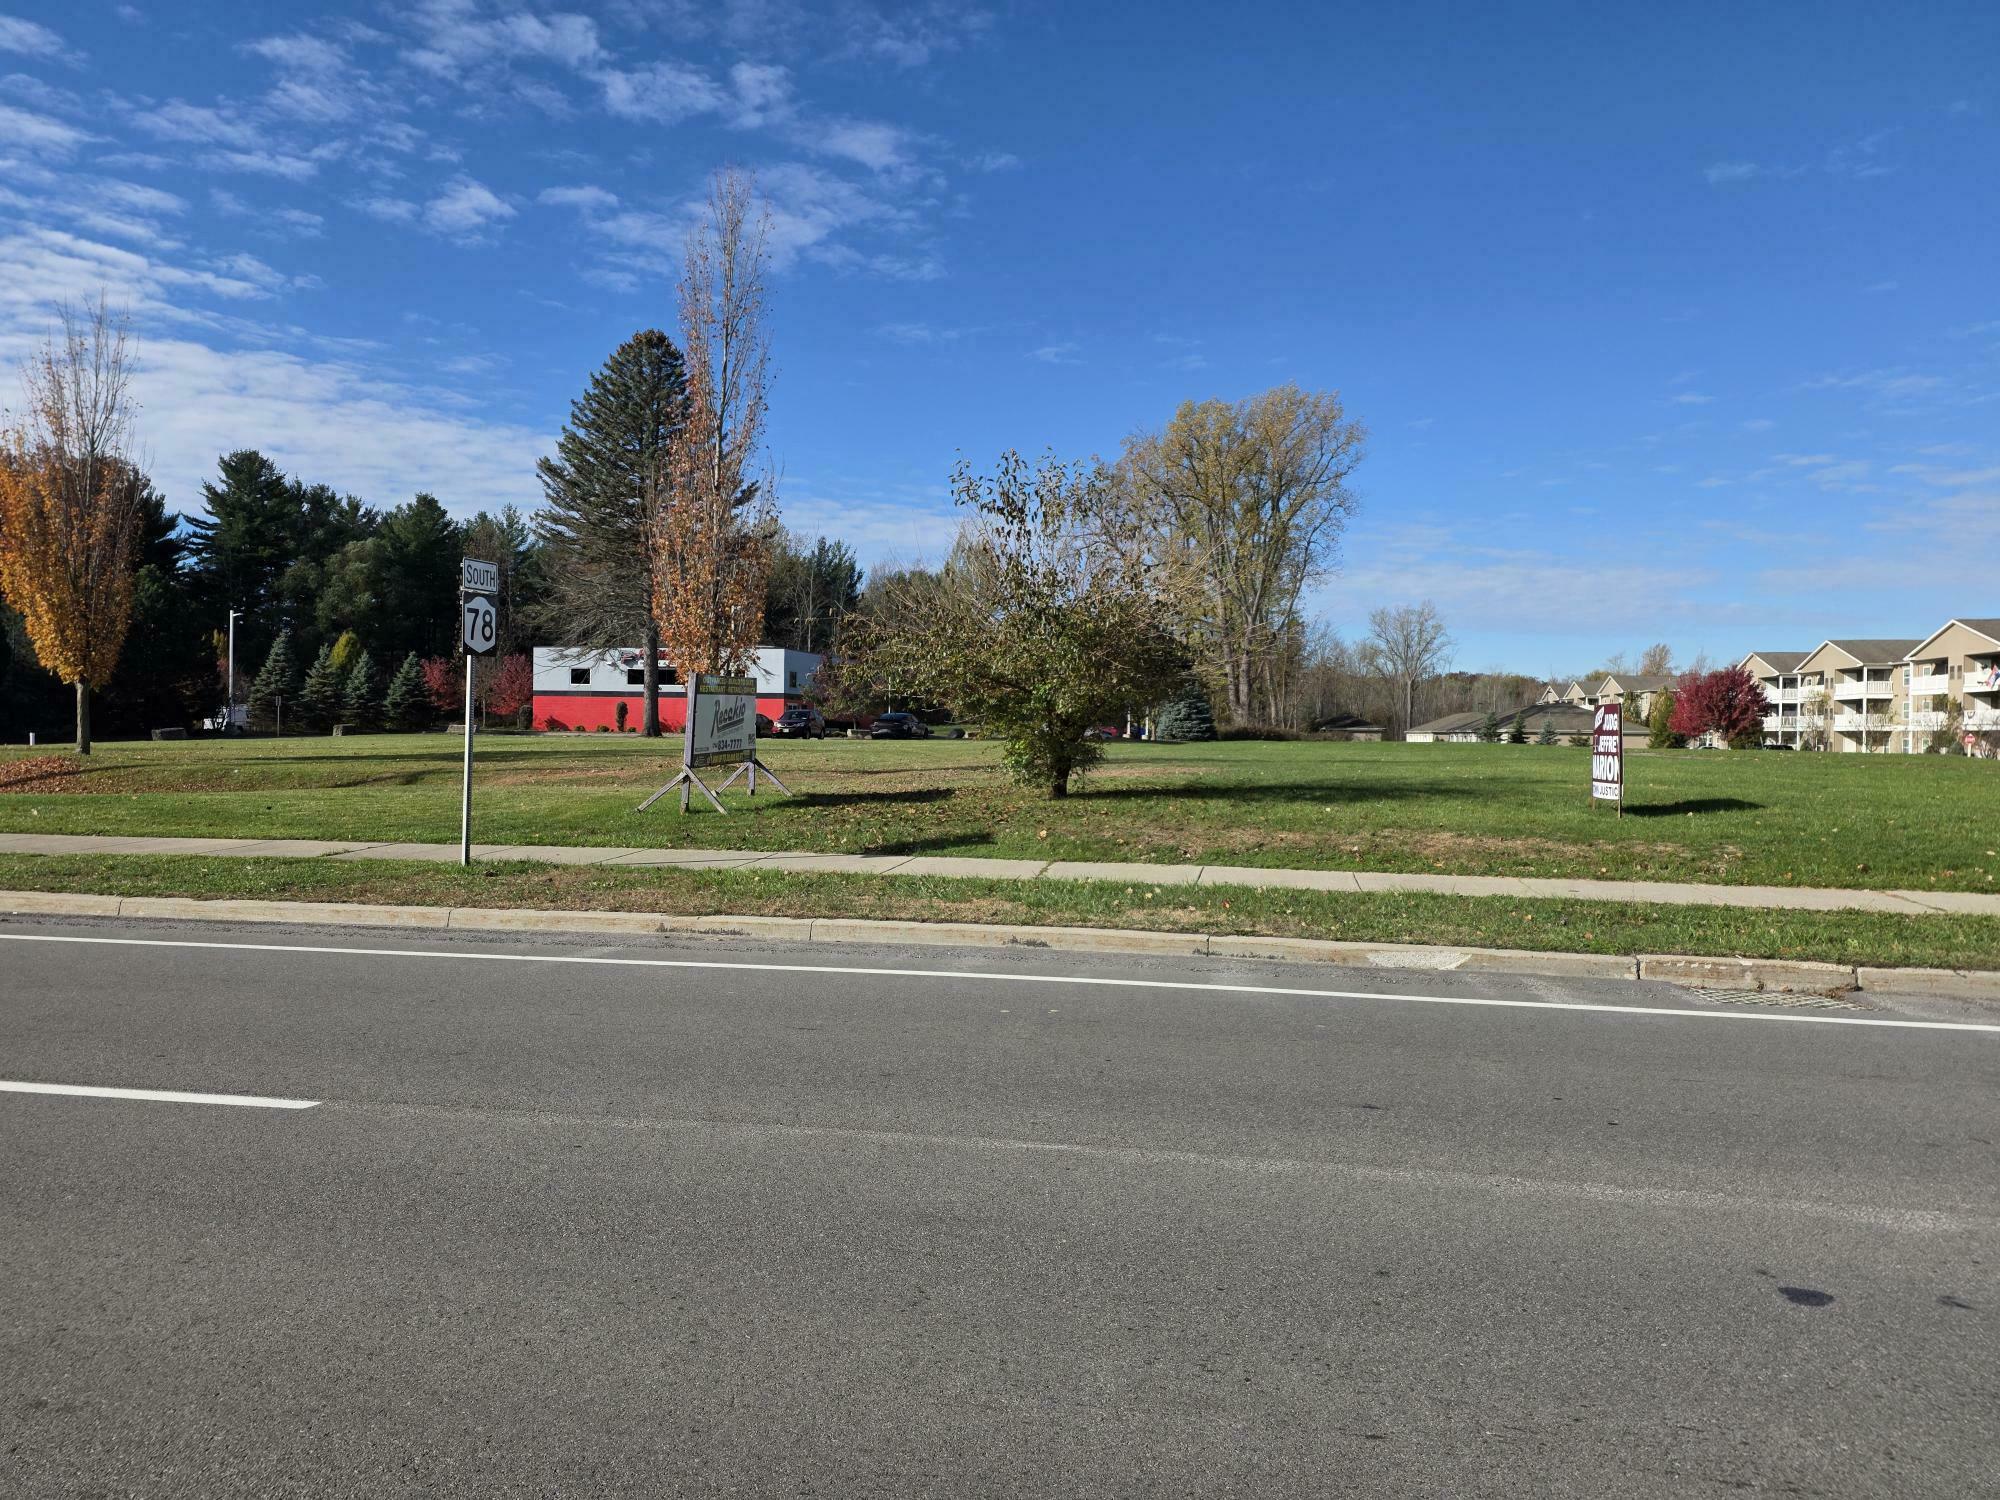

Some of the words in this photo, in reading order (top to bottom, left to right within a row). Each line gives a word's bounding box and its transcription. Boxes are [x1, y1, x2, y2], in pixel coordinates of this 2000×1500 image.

[466, 564, 496, 588] SOUTH
[466, 607, 493, 642] 78
[1603, 713, 1619, 731] JUDG
[717, 738, 743, 751] 834-7777
[1599, 785, 1619, 797] JUSTIC
